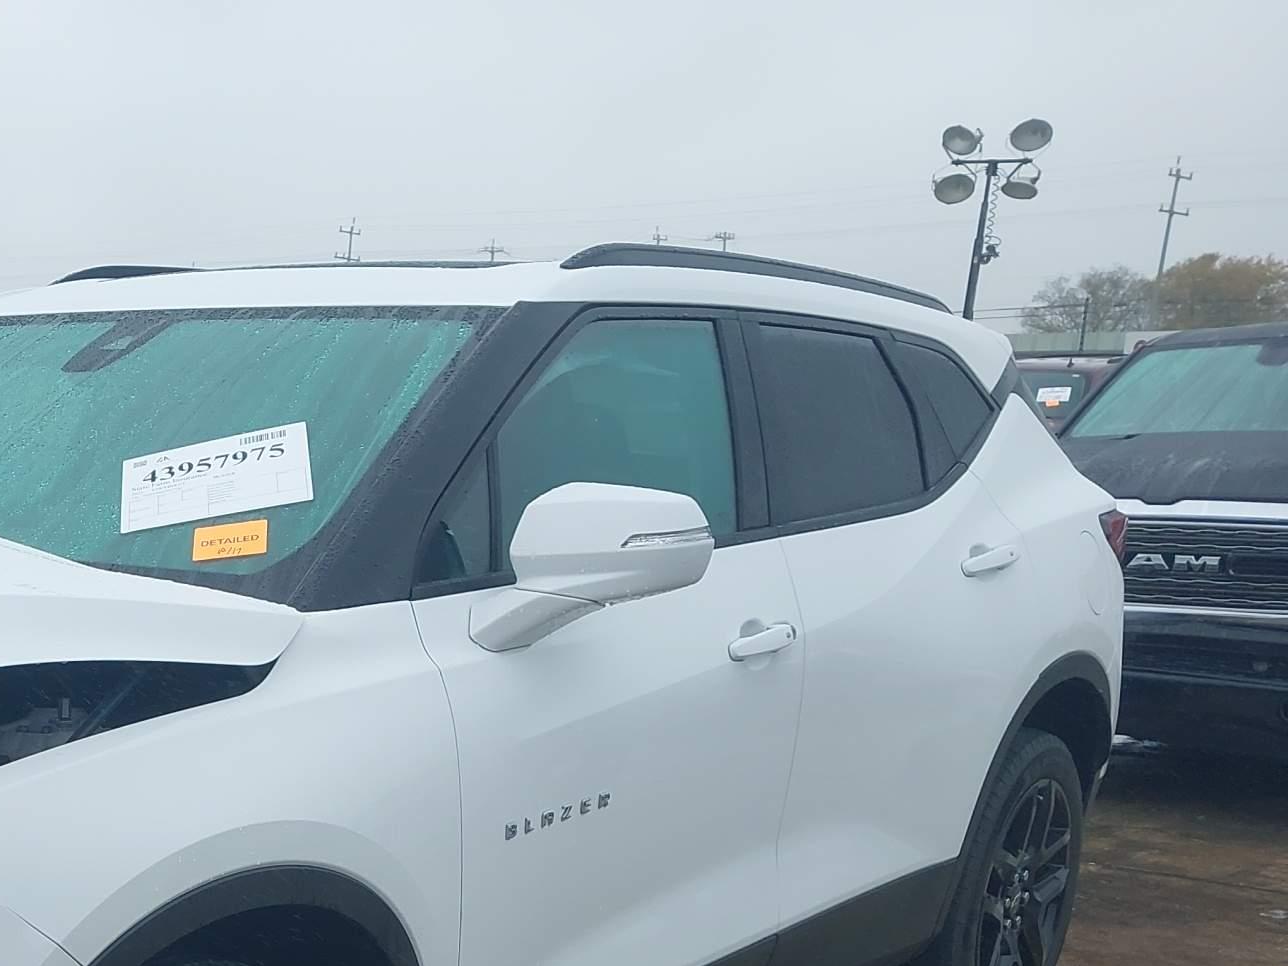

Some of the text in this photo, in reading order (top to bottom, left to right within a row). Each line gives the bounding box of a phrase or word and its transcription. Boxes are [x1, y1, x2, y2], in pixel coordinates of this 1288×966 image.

[142, 442, 285, 483] 43957975
[201, 534, 260, 547] DETAILED
[1126, 552, 1222, 573] AM
[504, 792, 611, 841] BLAZER
